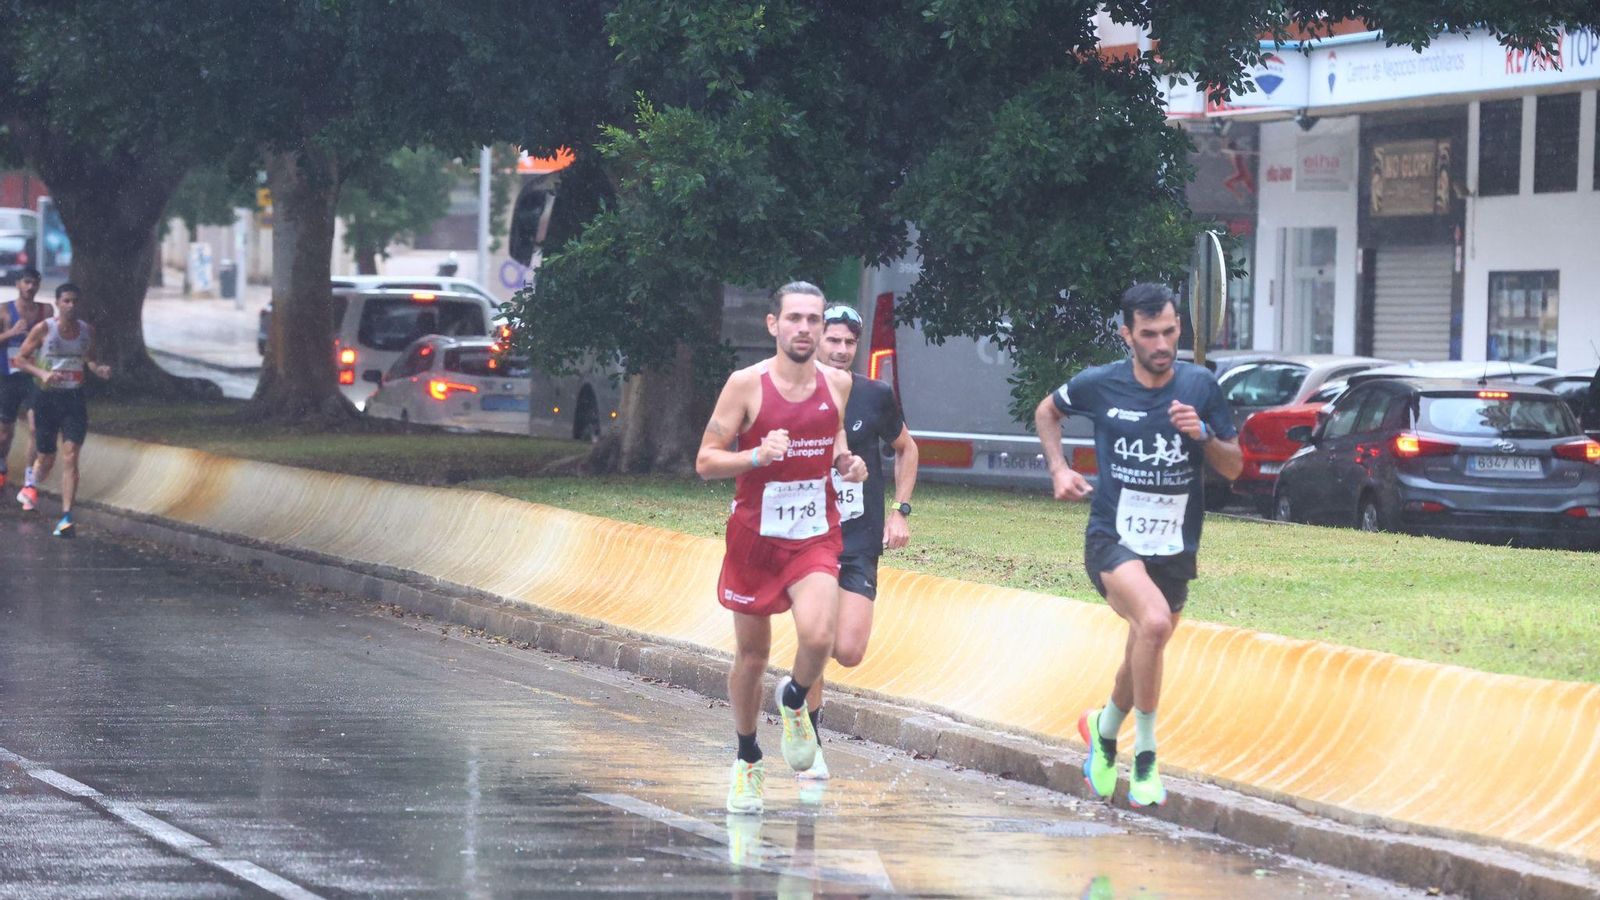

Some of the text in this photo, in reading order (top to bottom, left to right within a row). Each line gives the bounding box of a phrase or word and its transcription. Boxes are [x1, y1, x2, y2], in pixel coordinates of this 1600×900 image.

[1567, 25, 1600, 69] TOP
[1401, 153, 1433, 177] GLORY
[1111, 463, 1155, 478] CARRERA
[1513, 456, 1537, 470] KYP
[1111, 470, 1155, 486] URBANA
[1125, 515, 1178, 536] 13771
